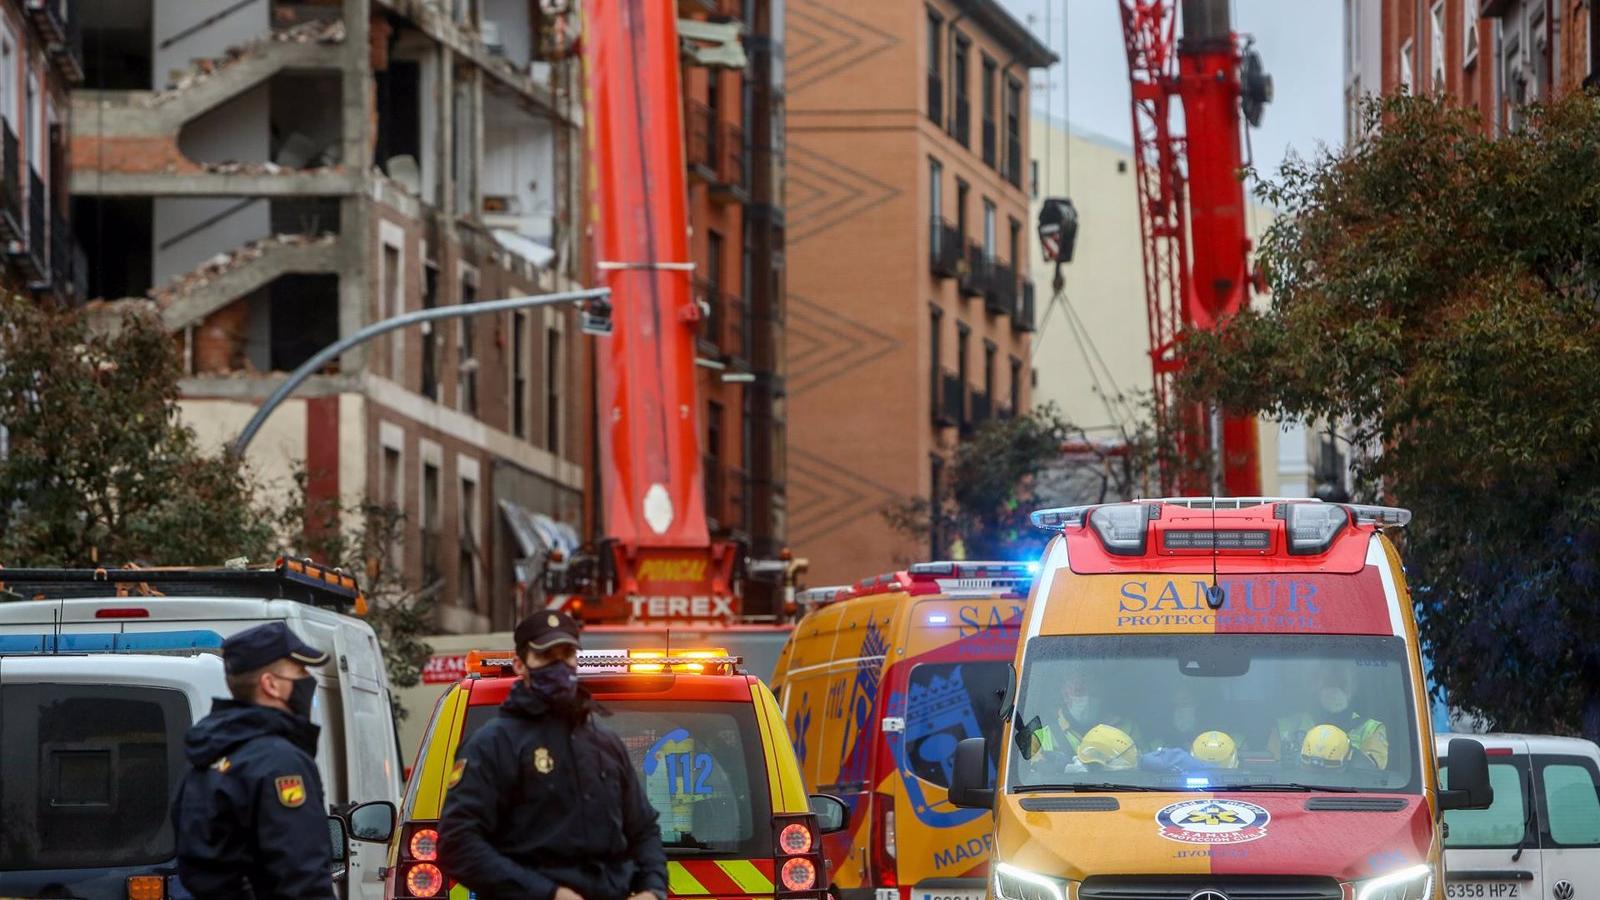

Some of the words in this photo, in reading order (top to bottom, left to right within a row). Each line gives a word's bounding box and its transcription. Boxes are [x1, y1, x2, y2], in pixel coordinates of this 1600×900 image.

[626, 595, 735, 617] TEREX
[1119, 579, 1320, 613] SAMUR
[576, 654, 626, 668] OMBEROS
[665, 752, 713, 795] 112
[1447, 884, 1484, 898] 6358
[1490, 884, 1518, 898] HPZ
